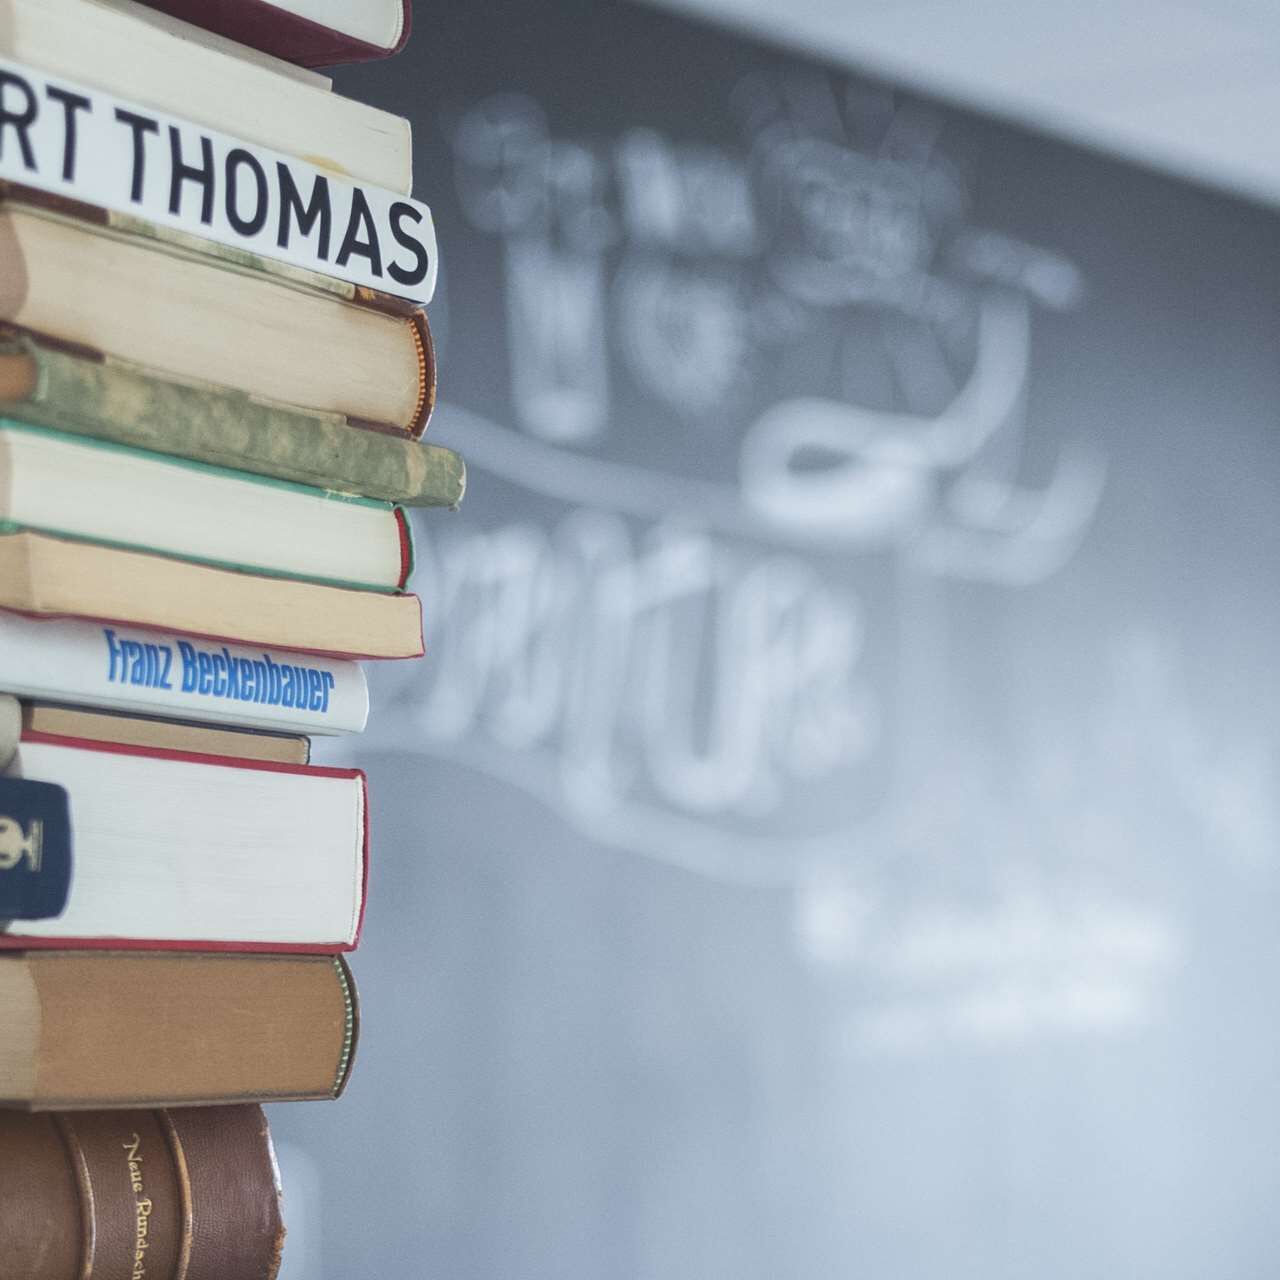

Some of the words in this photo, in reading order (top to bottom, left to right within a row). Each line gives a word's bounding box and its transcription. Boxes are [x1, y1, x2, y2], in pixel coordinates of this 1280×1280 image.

[114, 106, 430, 287] THOMAS
[104, 628, 174, 690] Franz
[177, 640, 335, 713] Beckenbauer
[122, 1132, 144, 1193] Neue
